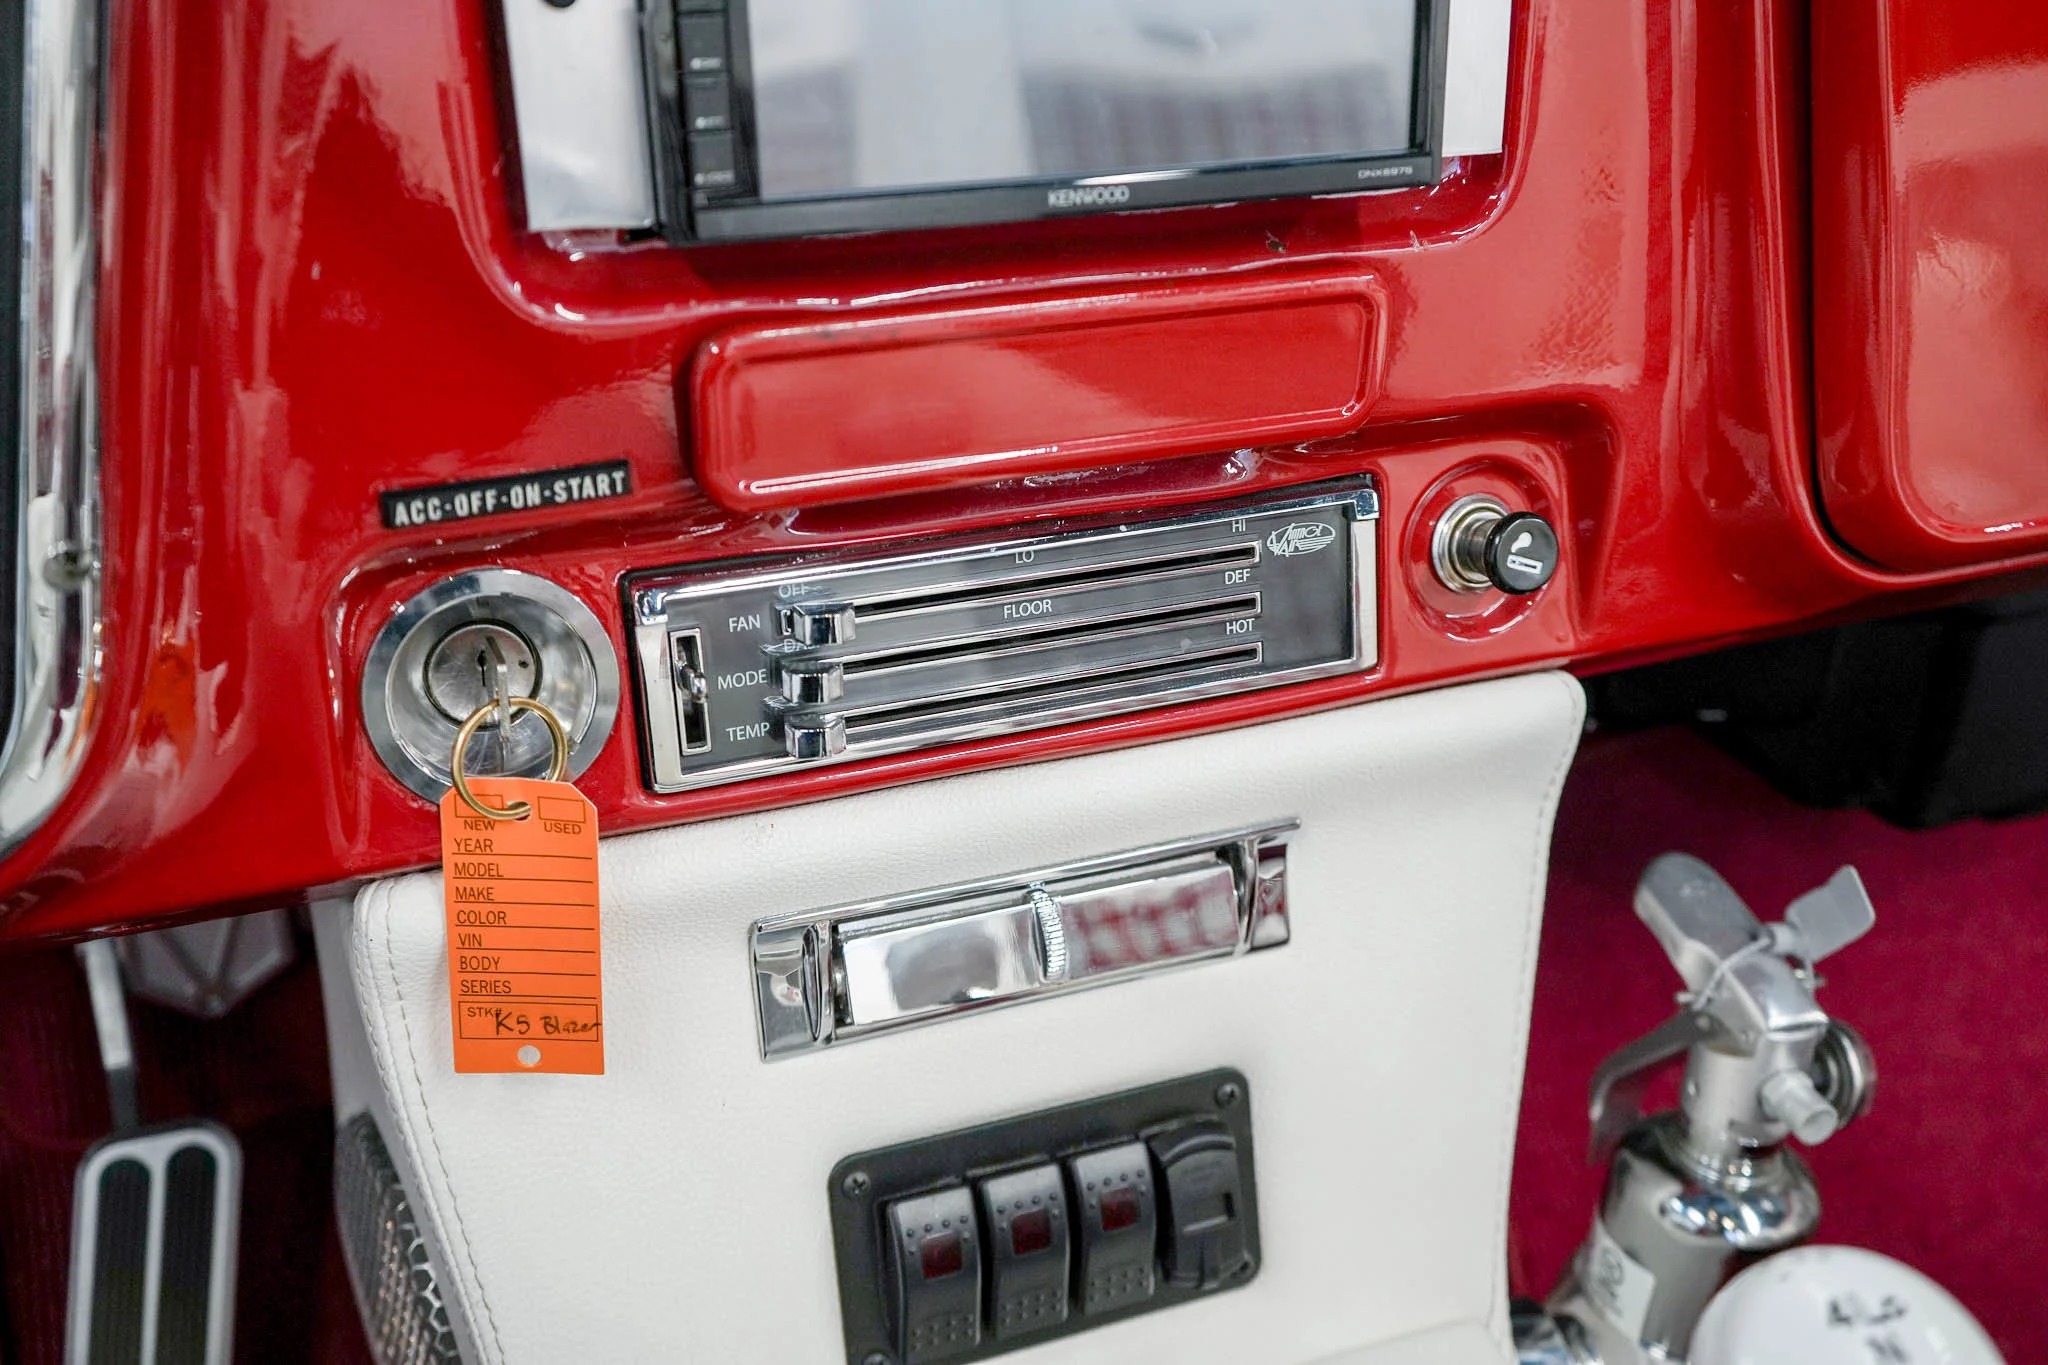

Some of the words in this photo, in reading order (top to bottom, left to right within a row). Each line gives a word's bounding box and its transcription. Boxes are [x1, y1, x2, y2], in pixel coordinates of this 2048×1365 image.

[1047, 185, 1130, 208] KENWOOD
[1232, 519, 1246, 533] HI
[1015, 550, 1035, 564] LO
[1224, 568, 1251, 585] DEF
[1003, 599, 1053, 619] FLOOR
[728, 614, 761, 633] FAN
[1226, 618, 1255, 635] HOT
[717, 668, 768, 690] MODE
[726, 722, 770, 742] TEMP
[463, 819, 496, 831] NEW
[543, 822, 582, 835] USED
[454, 838, 494, 853] YEAR
[454, 862, 504, 878] MODEL
[455, 886, 495, 901] MAKE
[456, 910, 507, 925] COLOR
[458, 933, 483, 948] VIN
[459, 955, 501, 971] BODY
[460, 979, 512, 994] SERIES
